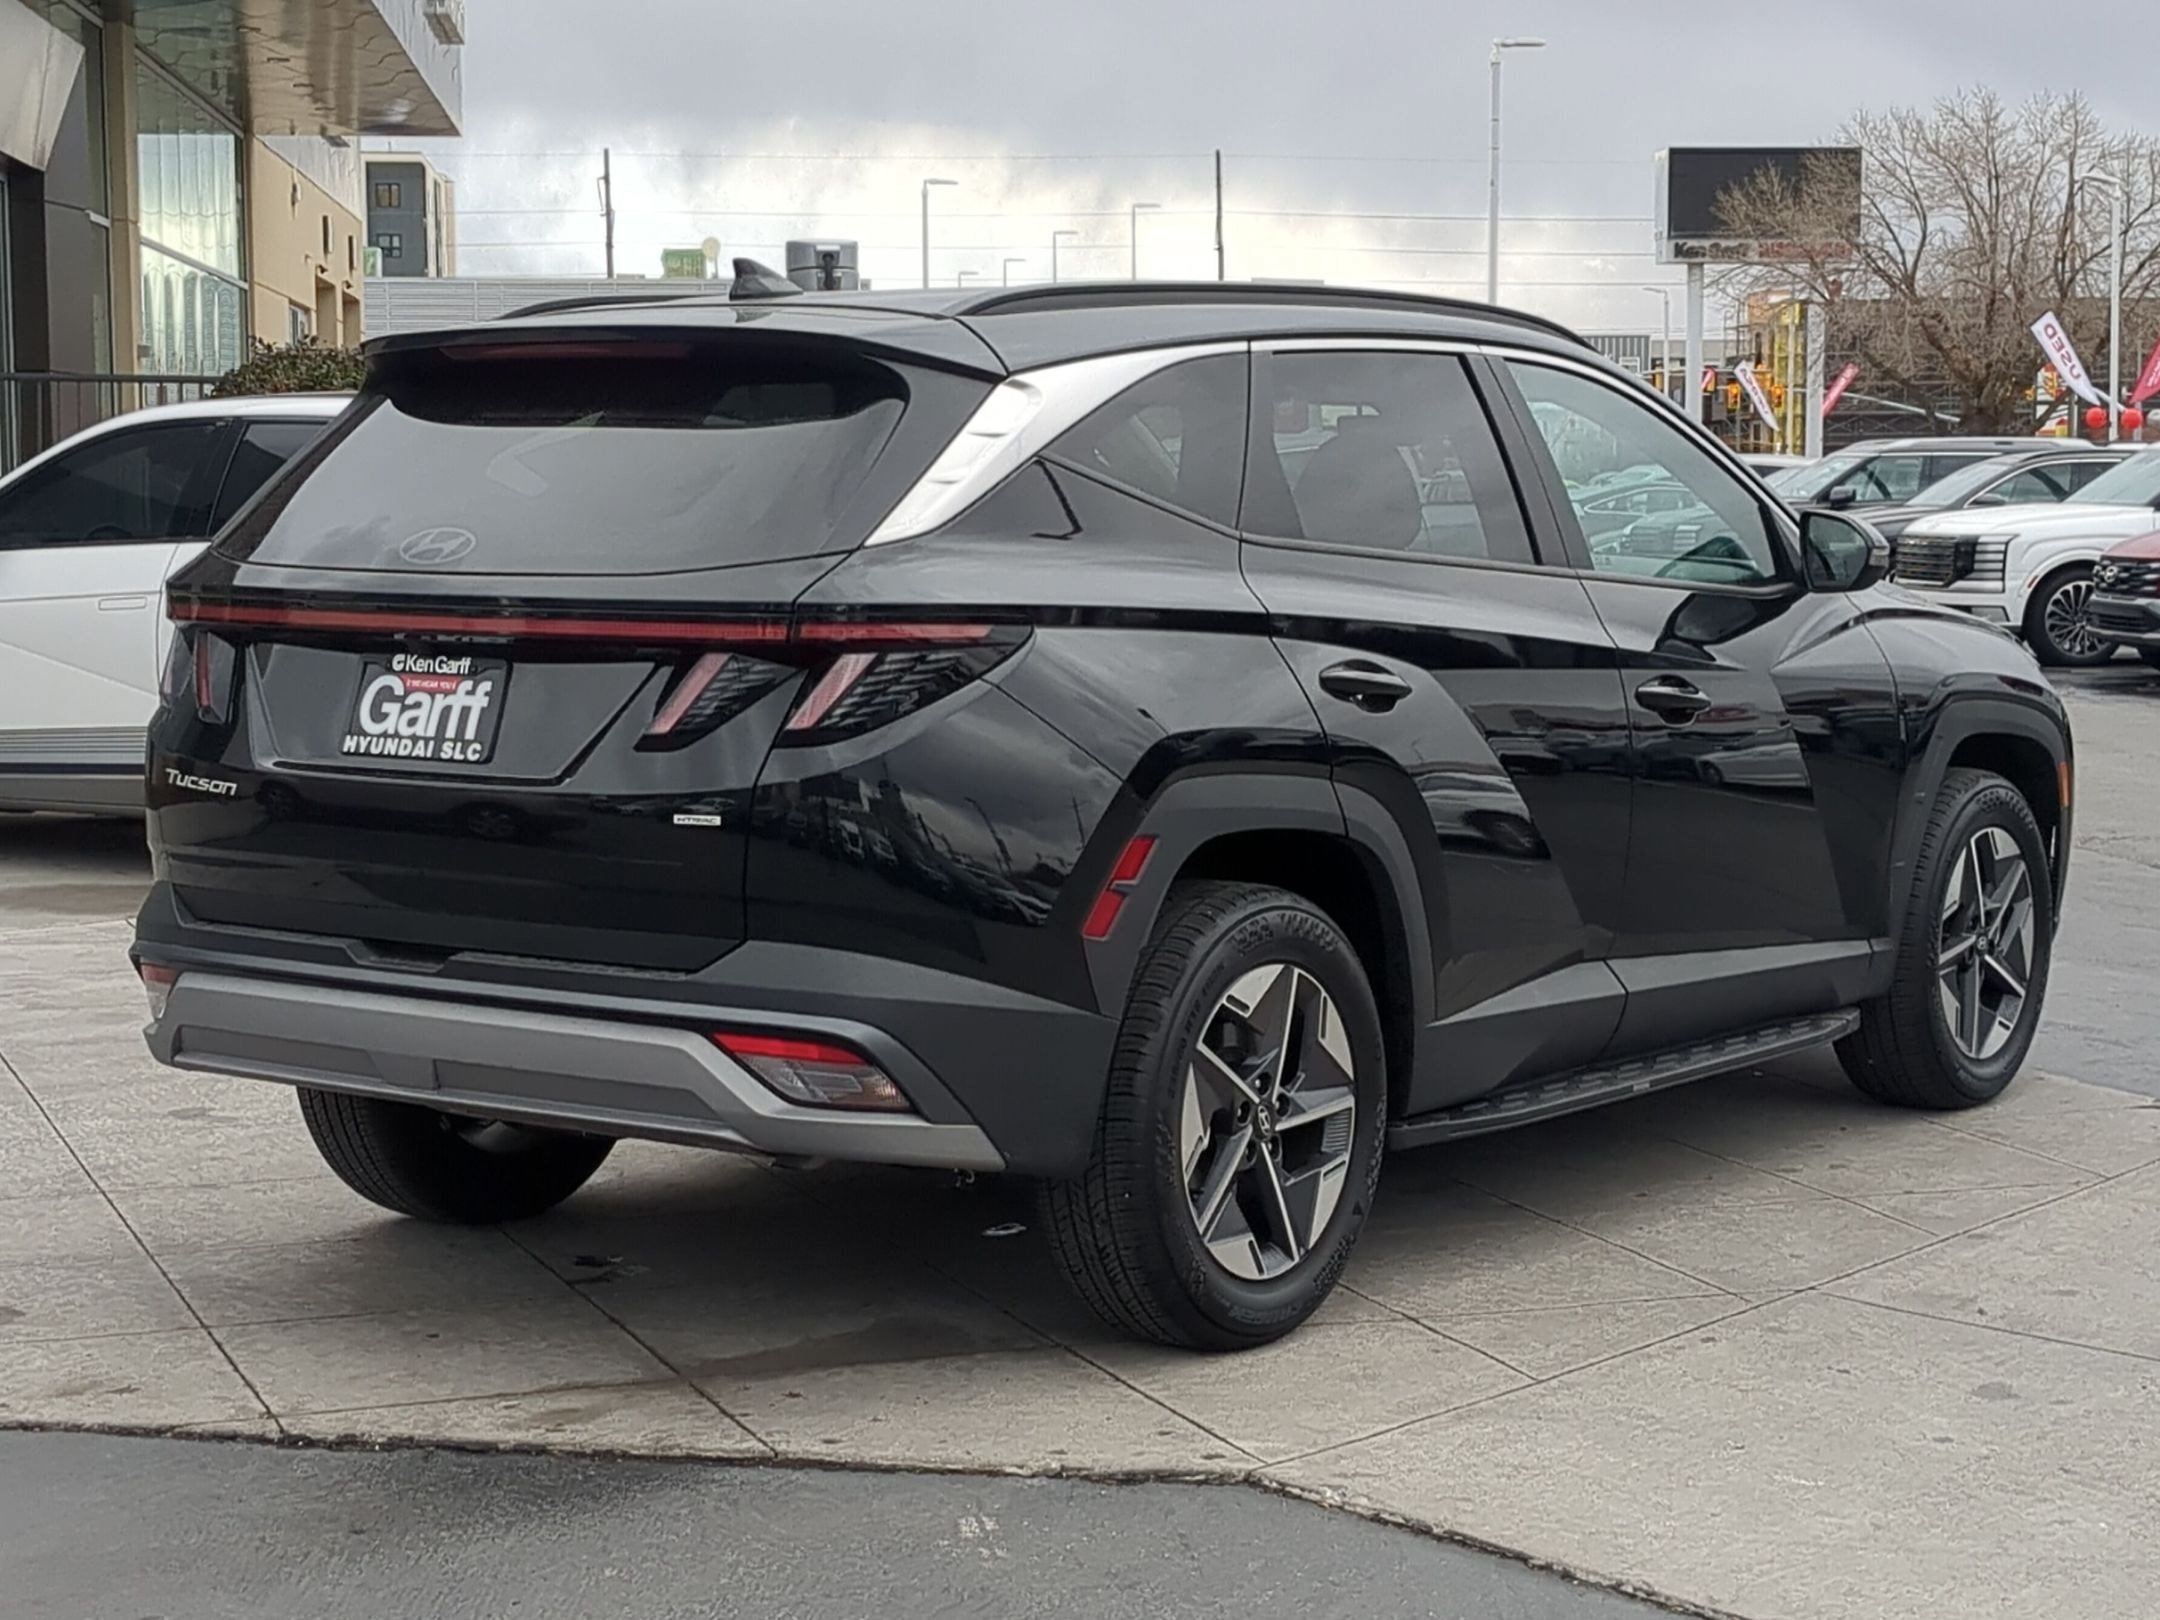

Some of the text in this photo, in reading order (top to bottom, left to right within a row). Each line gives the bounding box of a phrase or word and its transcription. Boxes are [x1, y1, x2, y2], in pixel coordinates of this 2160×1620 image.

[359, 674, 492, 740] Garff
[342, 735, 483, 761] HYUNDAI SLC
